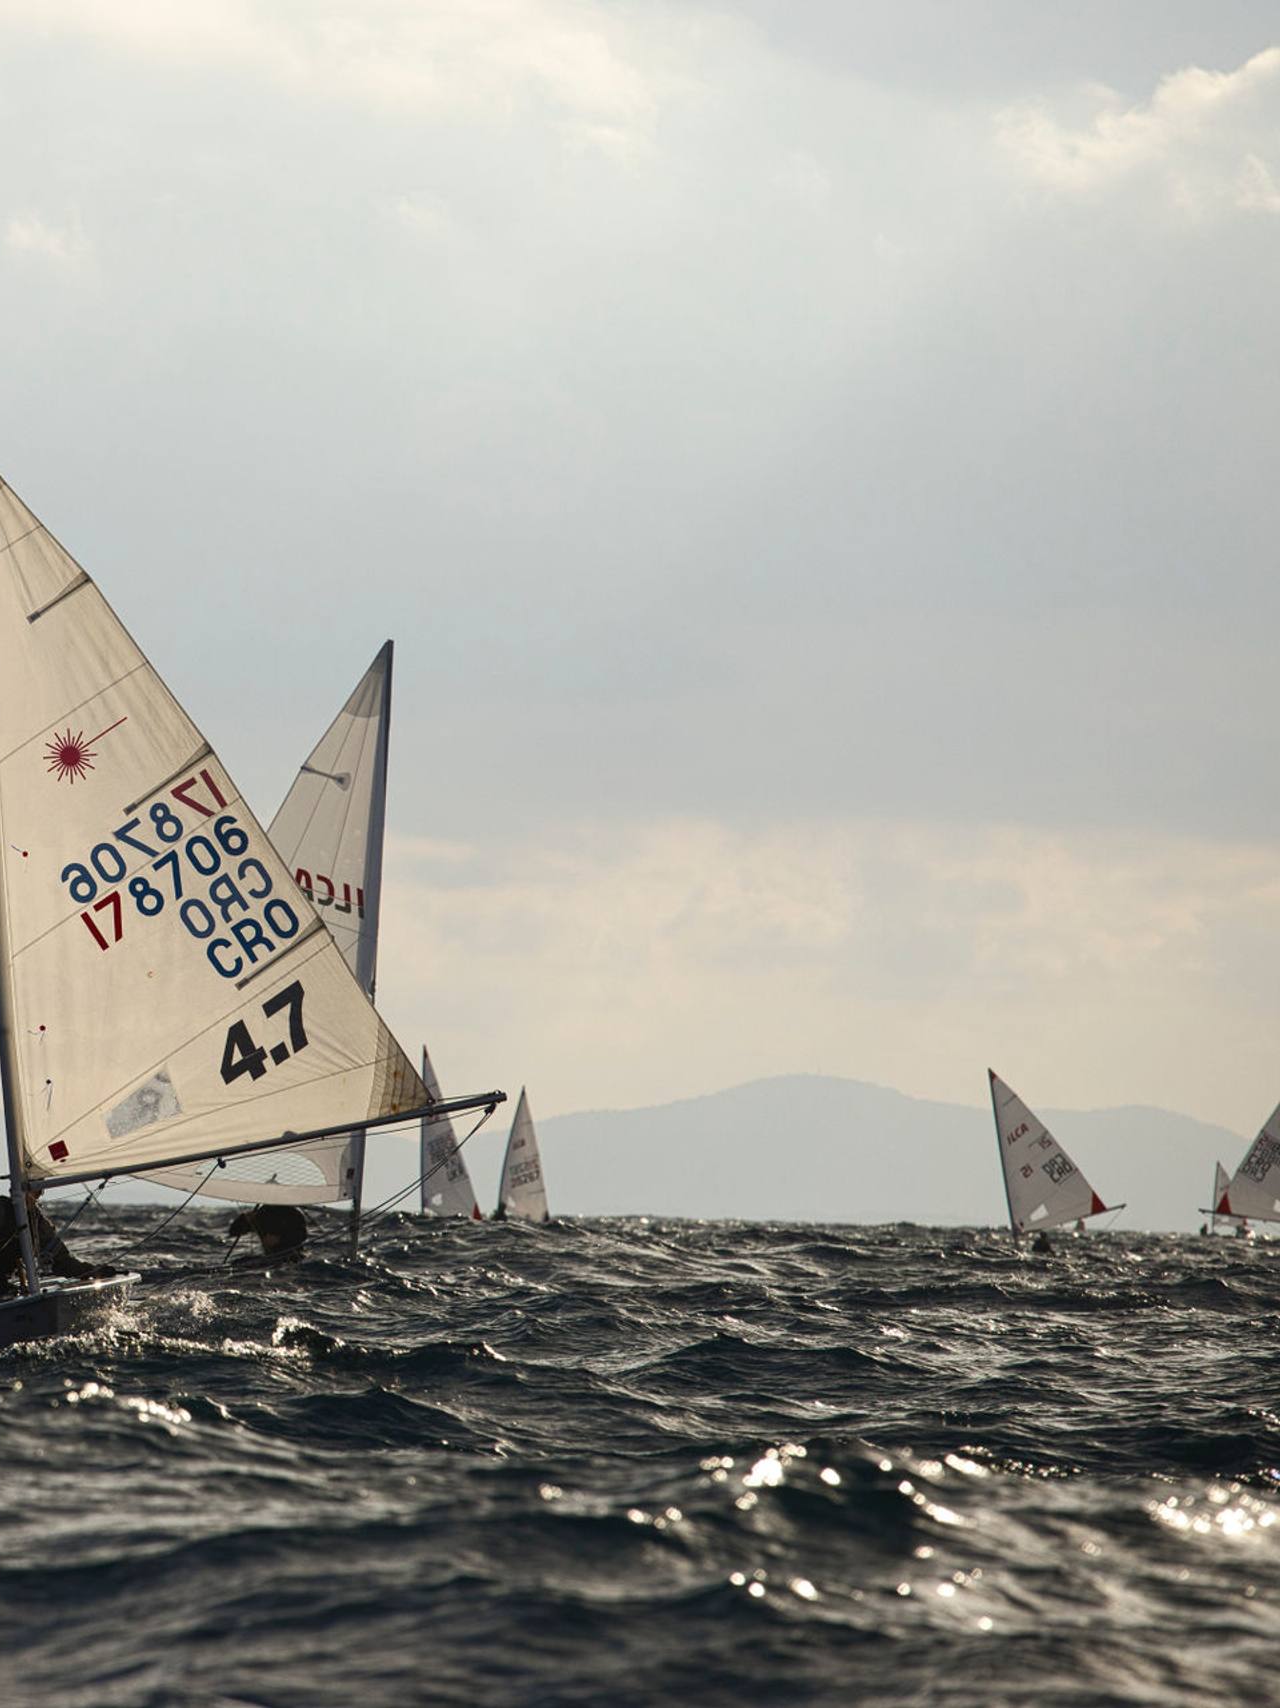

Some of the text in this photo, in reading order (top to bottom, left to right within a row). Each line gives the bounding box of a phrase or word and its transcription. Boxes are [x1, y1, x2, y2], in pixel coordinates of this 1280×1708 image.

[80, 815, 249, 951] 178706
[206, 899, 299, 978] CRO
[219, 980, 309, 1085] 4.7
[1007, 1123, 1029, 1145] ILCA
